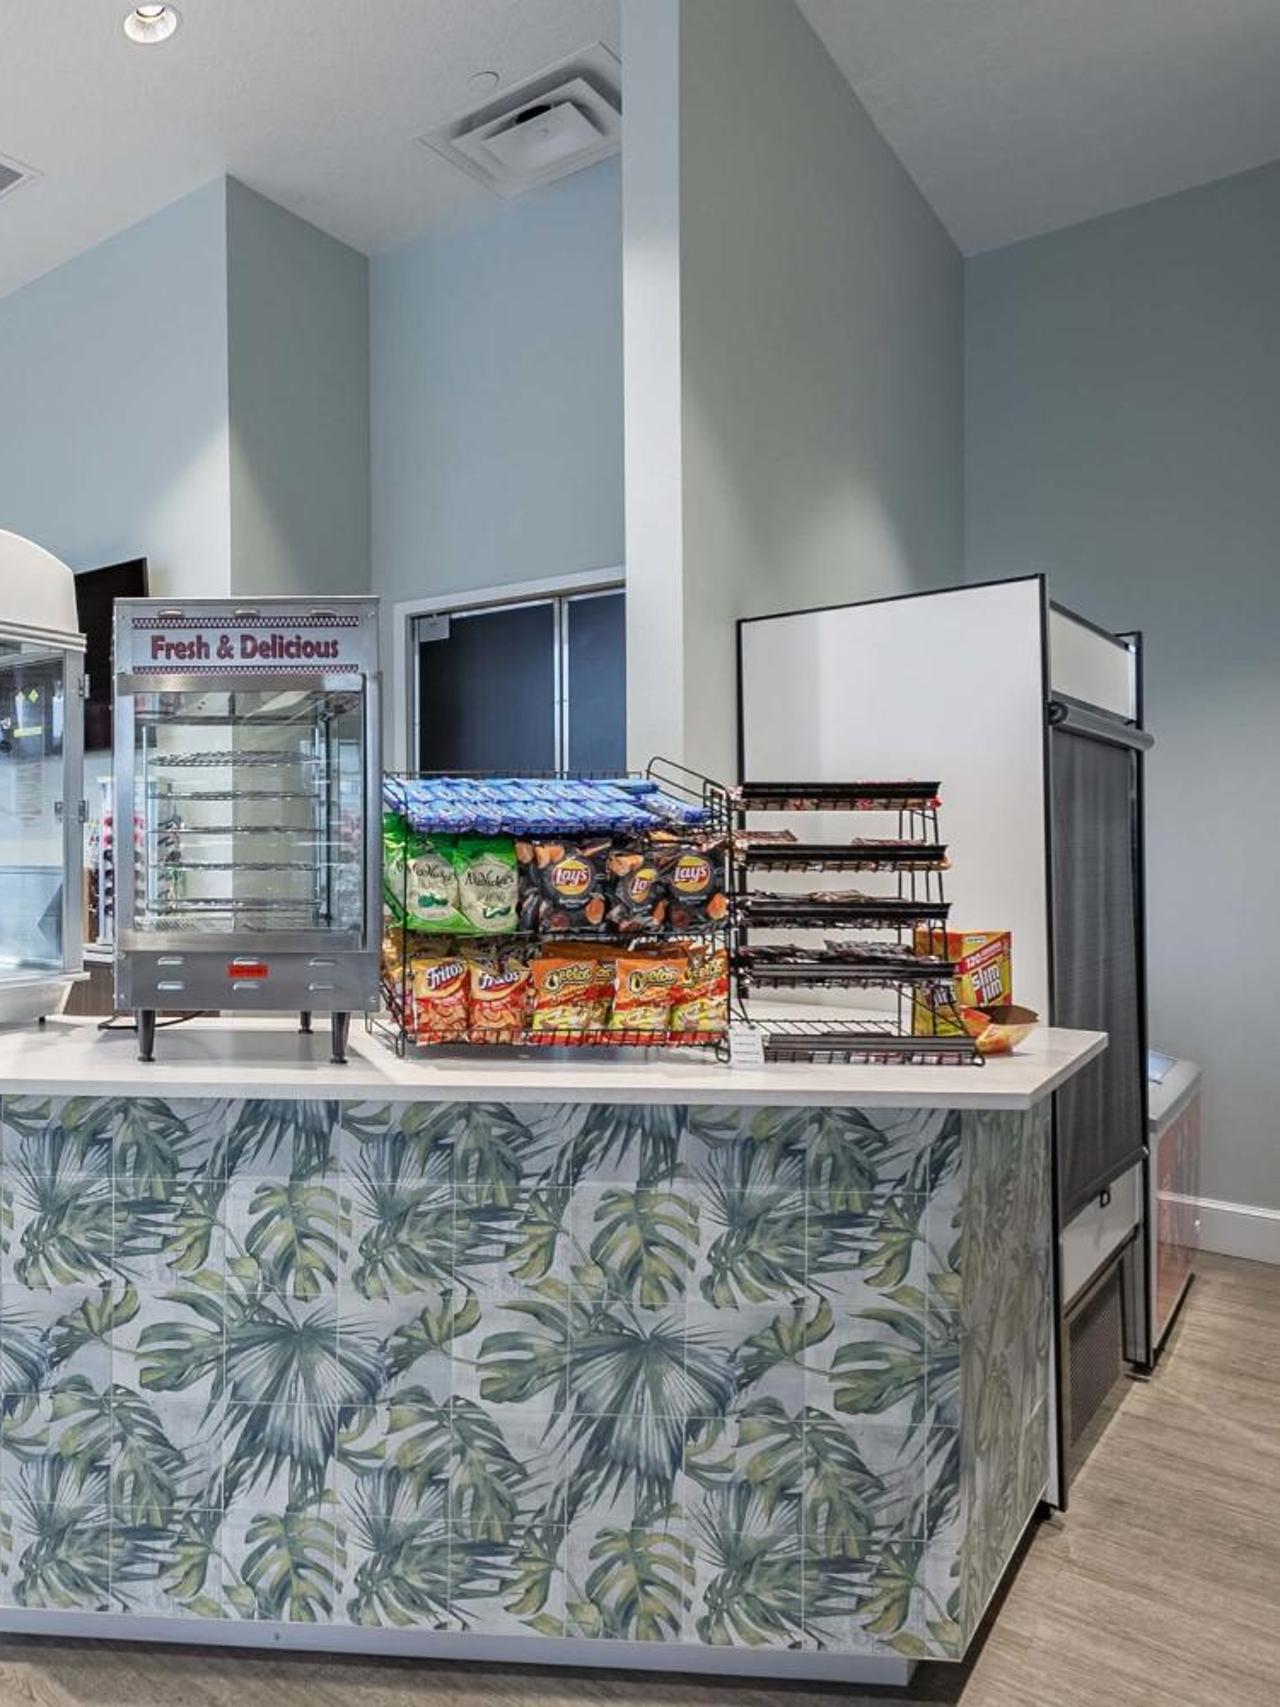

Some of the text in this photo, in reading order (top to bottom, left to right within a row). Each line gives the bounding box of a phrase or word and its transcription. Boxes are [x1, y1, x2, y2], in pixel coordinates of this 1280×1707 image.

[151, 633, 339, 660] Fresh & Delicious
[427, 961, 464, 990] Fritos
